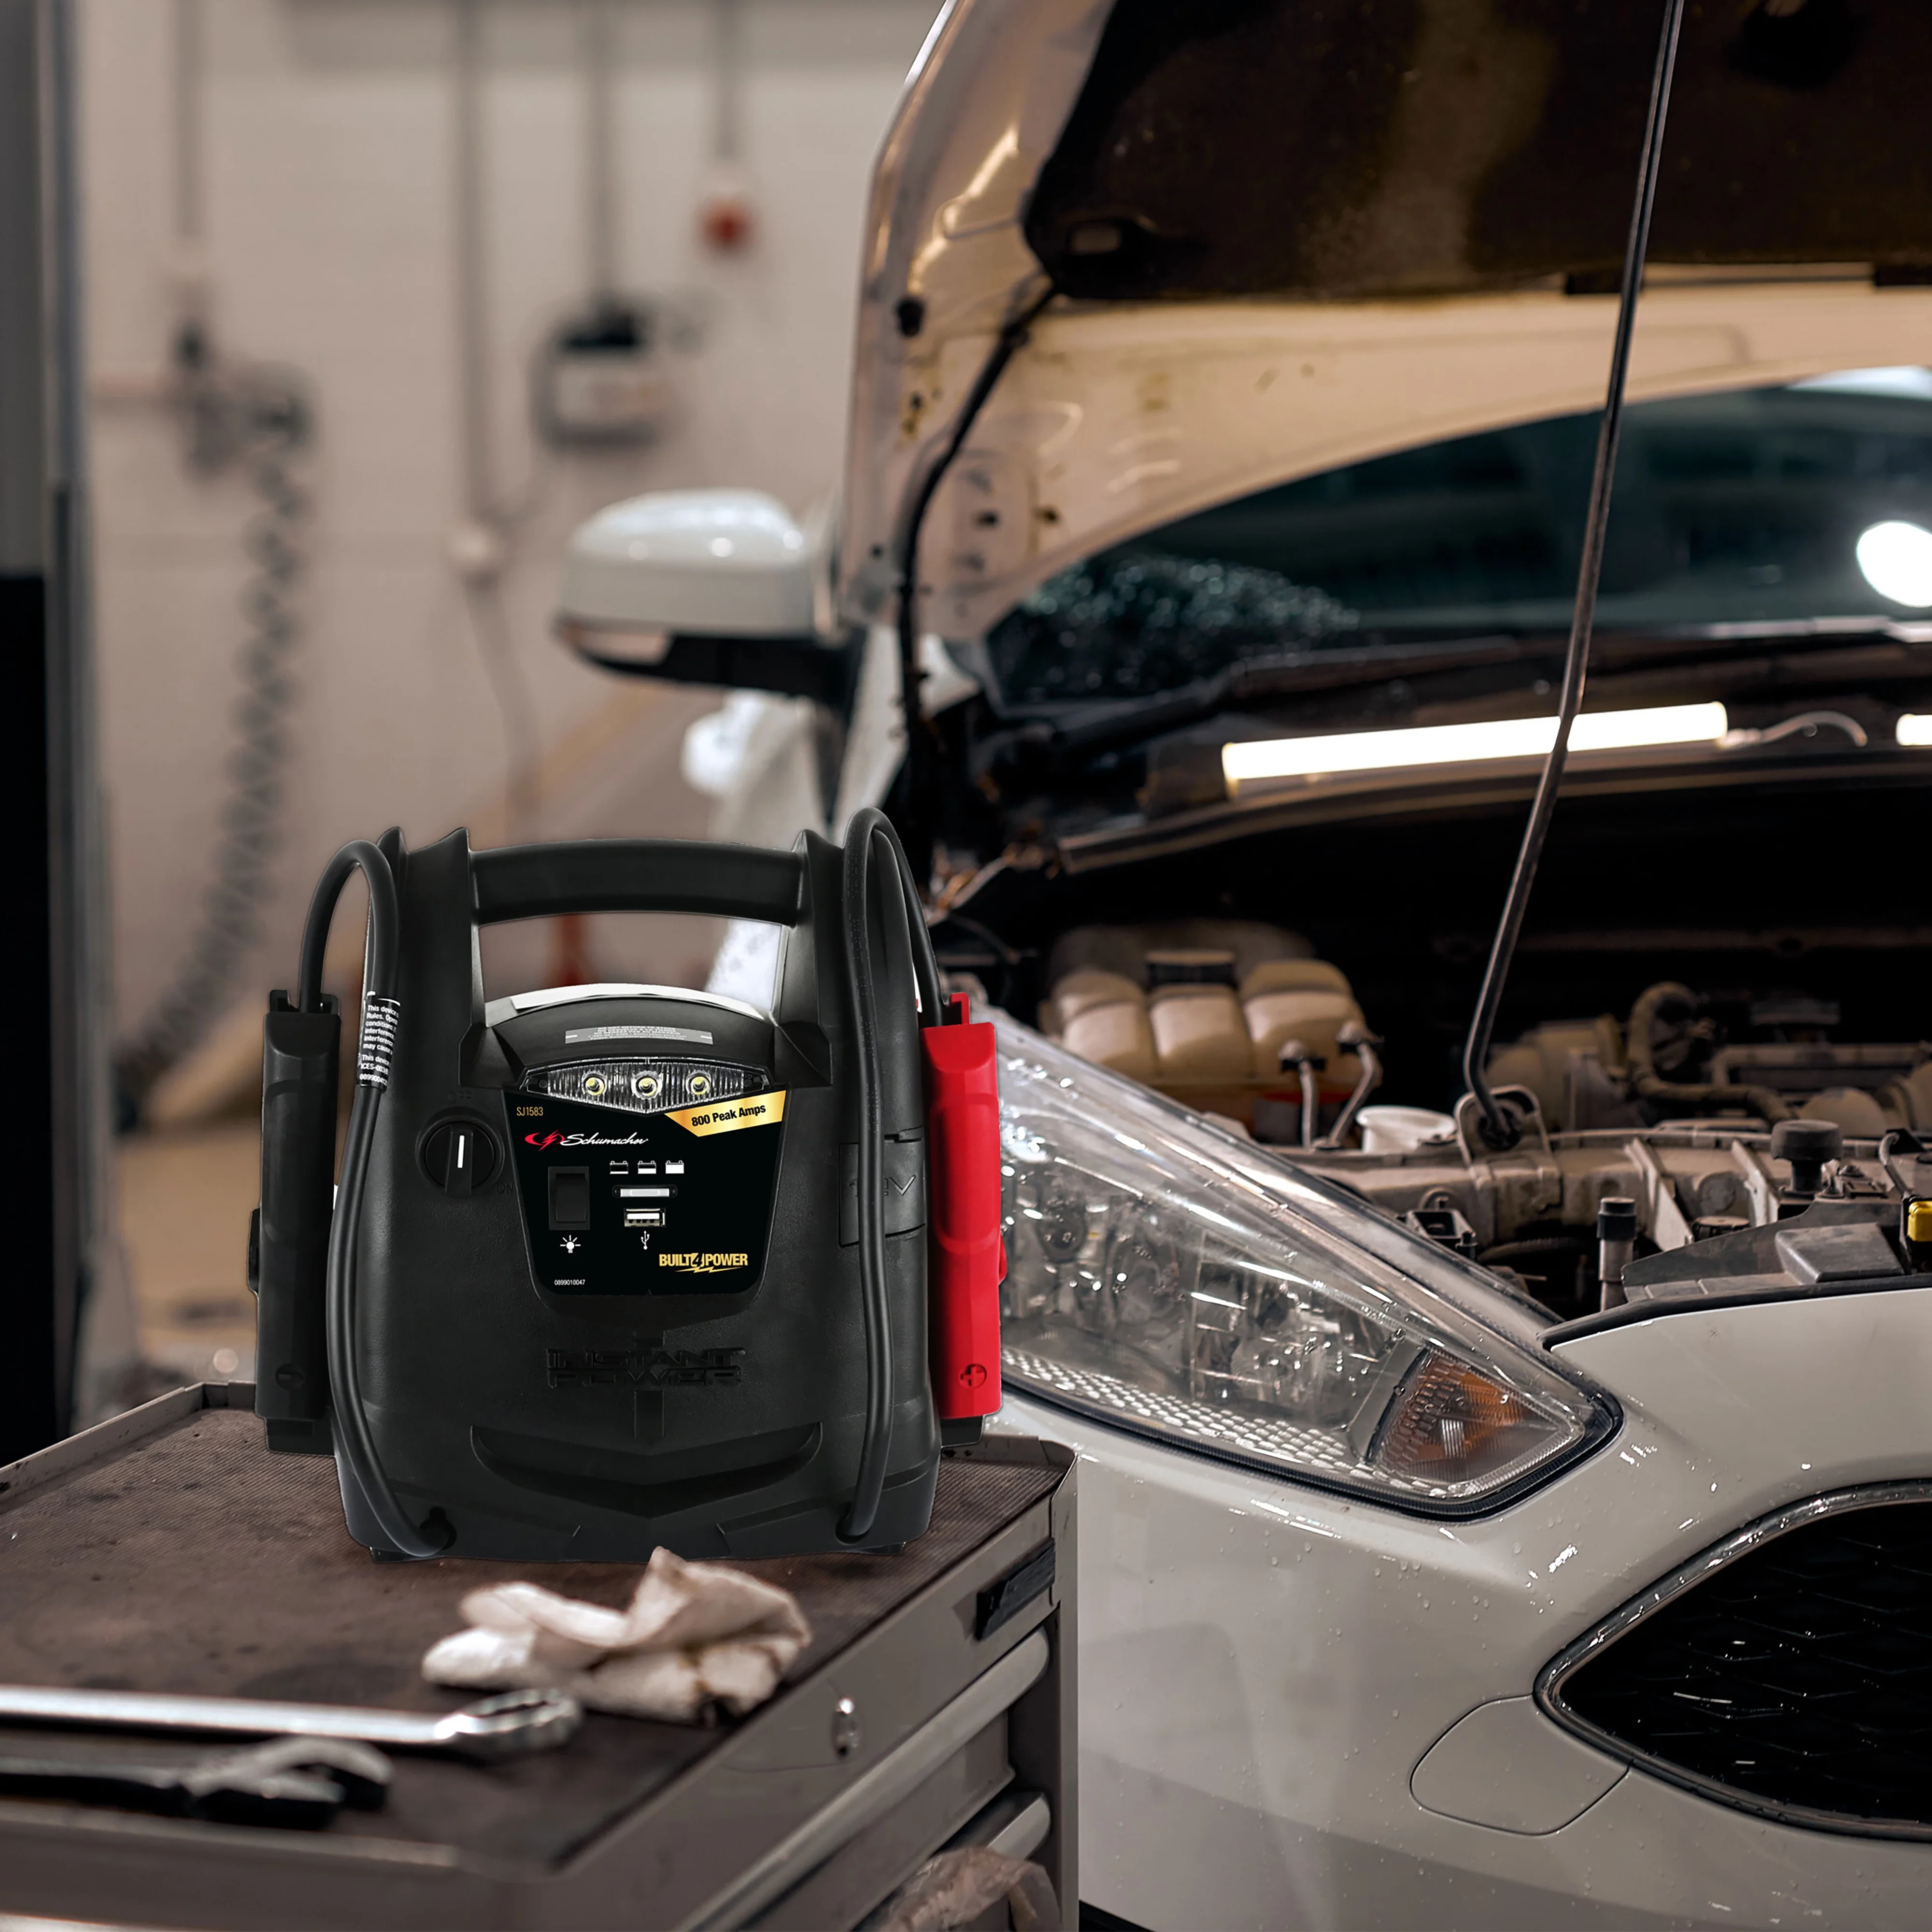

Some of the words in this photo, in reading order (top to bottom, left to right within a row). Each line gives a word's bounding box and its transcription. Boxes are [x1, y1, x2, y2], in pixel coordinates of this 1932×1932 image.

[516, 1107, 543, 1116] SJ1583
[691, 1114, 710, 1126] 800
[712, 1109, 737, 1122] Peak
[739, 1105, 766, 1117] Amps
[560, 1132, 648, 1146] Schumacher
[495, 1181, 515, 1194] ON
[546, 1348, 746, 1369] INSTANT
